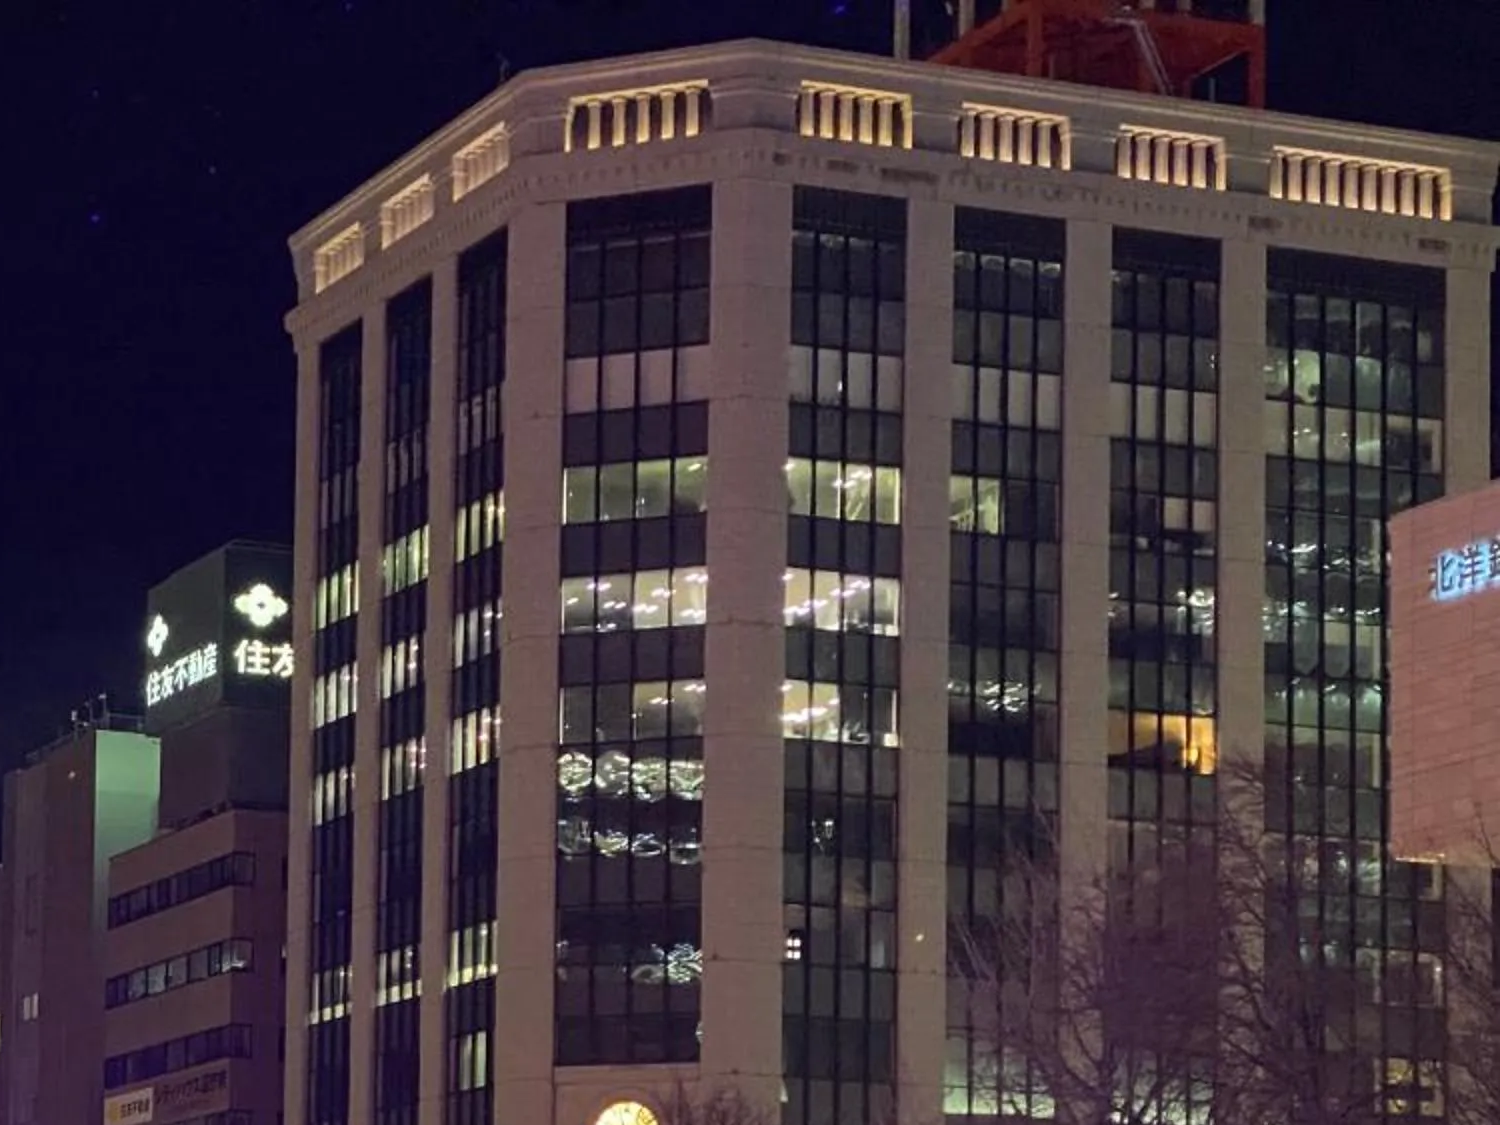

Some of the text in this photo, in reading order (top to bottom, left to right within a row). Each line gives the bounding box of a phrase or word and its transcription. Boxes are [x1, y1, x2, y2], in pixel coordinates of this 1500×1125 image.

[146, 642, 218, 707] 住友不動産
